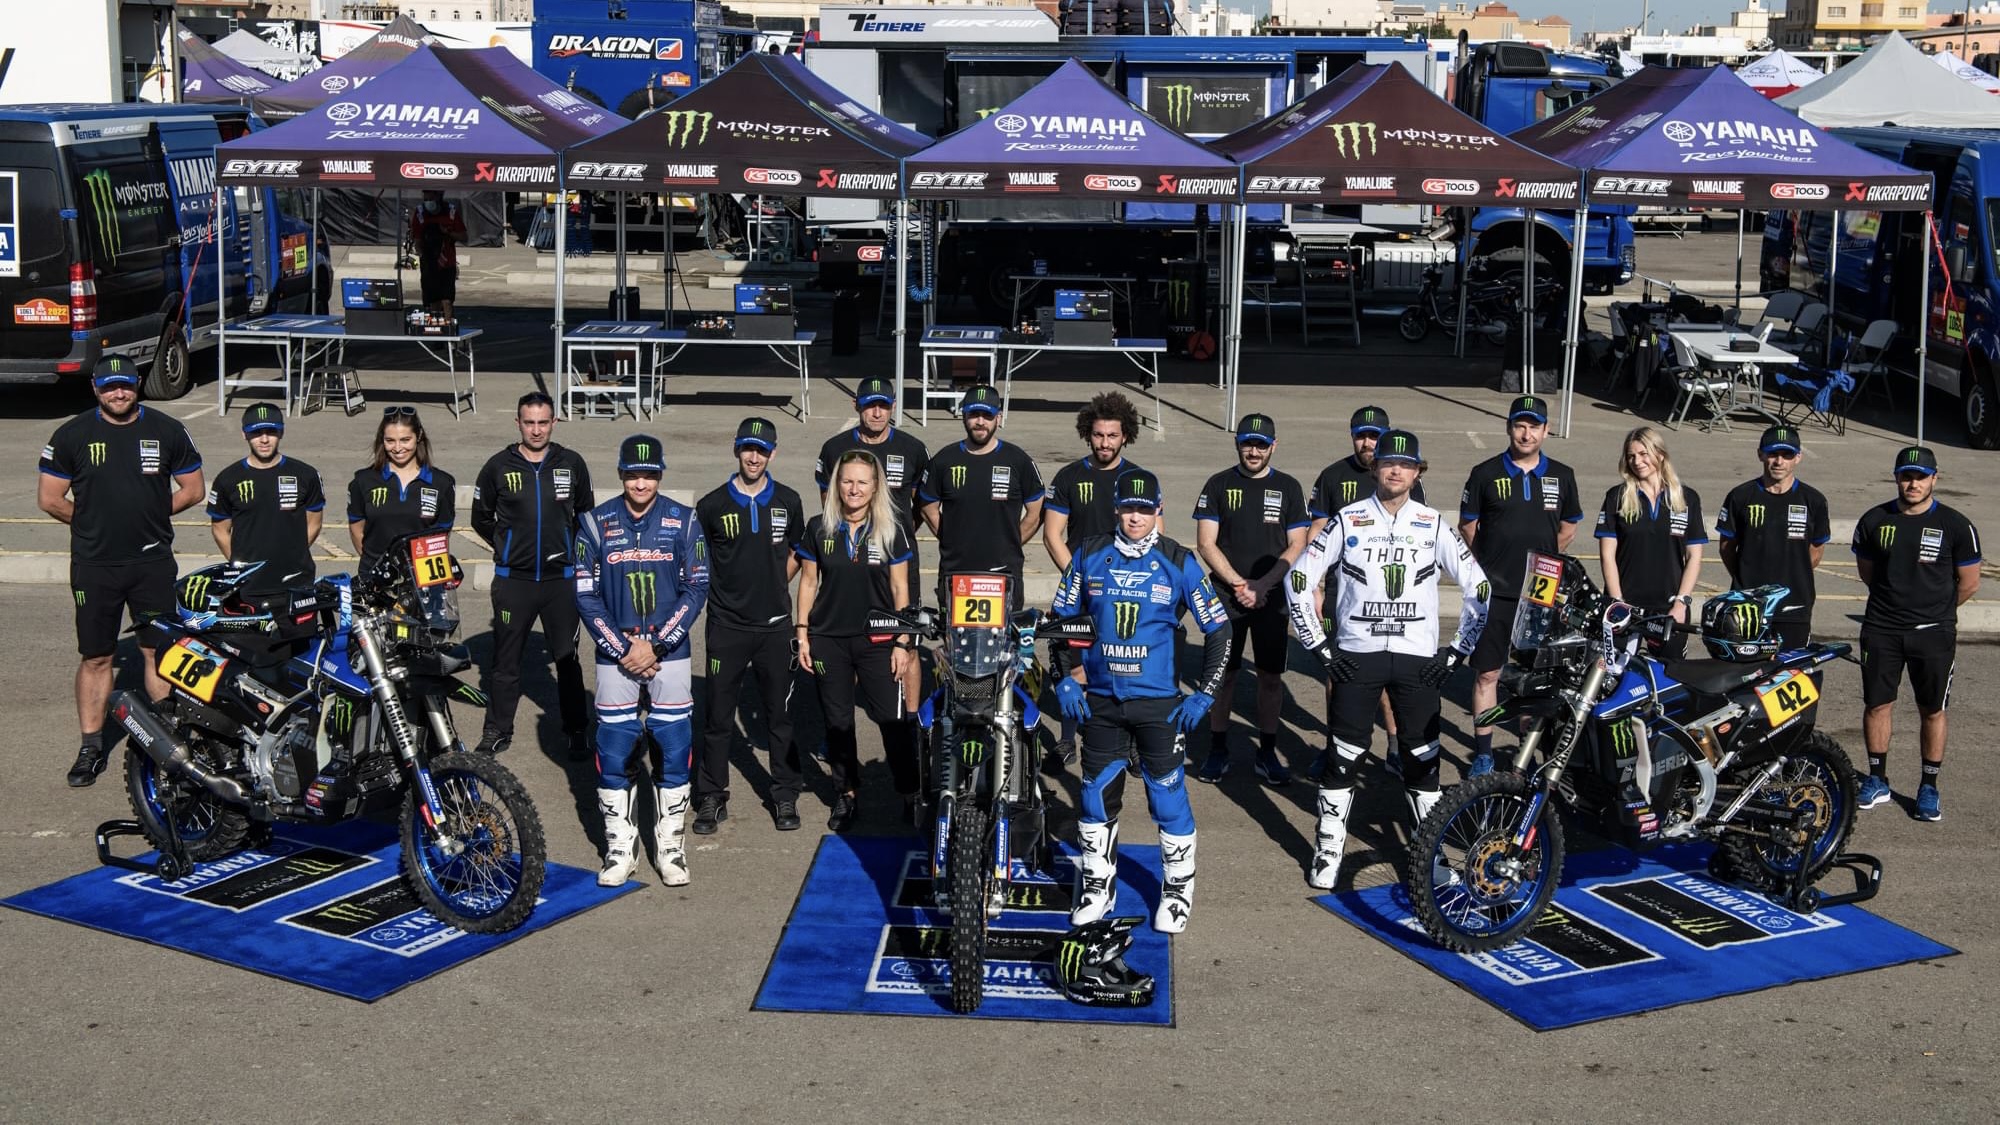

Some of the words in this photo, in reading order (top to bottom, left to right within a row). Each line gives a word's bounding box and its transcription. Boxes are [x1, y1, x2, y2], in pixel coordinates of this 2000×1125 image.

[549, 35, 655, 53] DRAGON
[1193, 91, 1250, 102] MONSTER
[365, 103, 480, 125] YAMAHA
[334, 121, 469, 130] RACING
[716, 119, 833, 137] MONSTER
[1030, 116, 1146, 136] YAMAHA
[733, 133, 813, 143] ENERGY
[1006, 133, 1138, 141] RACING
[1383, 128, 1500, 147] MONSTER
[1695, 120, 1818, 148] YAMAHA
[1402, 141, 1482, 151] ENERGY
[1678, 139, 1813, 154] RACING
[225, 159, 303, 174] GYTR
[322, 160, 373, 173] YAMALUBE
[404, 164, 424, 177] KS
[424, 166, 454, 176] TOOLS
[571, 163, 648, 178] GYTR
[667, 164, 717, 178] YAMALUBE
[169, 158, 216, 197] YAMAH
[746, 169, 768, 183] KS
[768, 173, 797, 182] TOOLS
[912, 173, 988, 186] GYTR
[1008, 172, 1057, 185] YAMALUBE
[1087, 175, 1107, 188] KS
[1107, 178, 1136, 188] TOOLS
[1345, 176, 1394, 190] YAMALUBE
[1247, 177, 1325, 191] GYTR
[1424, 181, 1446, 194] KS
[1446, 183, 1475, 192] TOOLS
[1594, 178, 1671, 193] GYTR
[1692, 180, 1744, 194] YAMALUBE
[1774, 185, 1795, 197] KS
[1795, 187, 1825, 196] TOOLS
[115, 182, 170, 205] MONSTER
[127, 206, 165, 217] ENERGY
[862, 248, 880, 258] KS
[48, 307, 68, 316] 2022
[428, 542, 446, 550] MOTUL
[607, 549, 674, 564] Outsiders
[1363, 548, 1417, 564] THOR
[425, 556, 446, 581] 16
[972, 582, 1001, 592] MOTUL
[1066, 572, 1082, 606] YAMAHA
[1107, 588, 1121, 597] FLY
[1121, 589, 1148, 598] RACING
[1527, 575, 1549, 600] 42
[294, 597, 317, 609] YAMAHA
[340, 584, 352, 628] 100%
[1191, 589, 1211, 625] YAMAHA
[1364, 603, 1416, 617] YAMAHA
[964, 598, 991, 623] 29
[869, 618, 900, 629] YAMAHA
[1061, 624, 1091, 634] YAMAHA
[1101, 643, 1149, 659] YAMAHA
[1604, 631, 1615, 666] OAKLEY
[322, 658, 339, 674] YAMAHA
[1108, 661, 1141, 673] YAMALUBE
[1629, 684, 1649, 697] YAMAHA
[1776, 680, 1810, 713] 42
[384, 693, 414, 751] YAMAHA
[424, 771, 440, 808] MICHELIN
[997, 821, 1007, 863] MICHELIN
[162, 851, 267, 891] YAMAHA
[1674, 876, 1760, 918] YAMAHA
[987, 937, 1044, 946] NSTER
[1093, 990, 1125, 999] MONSTER
